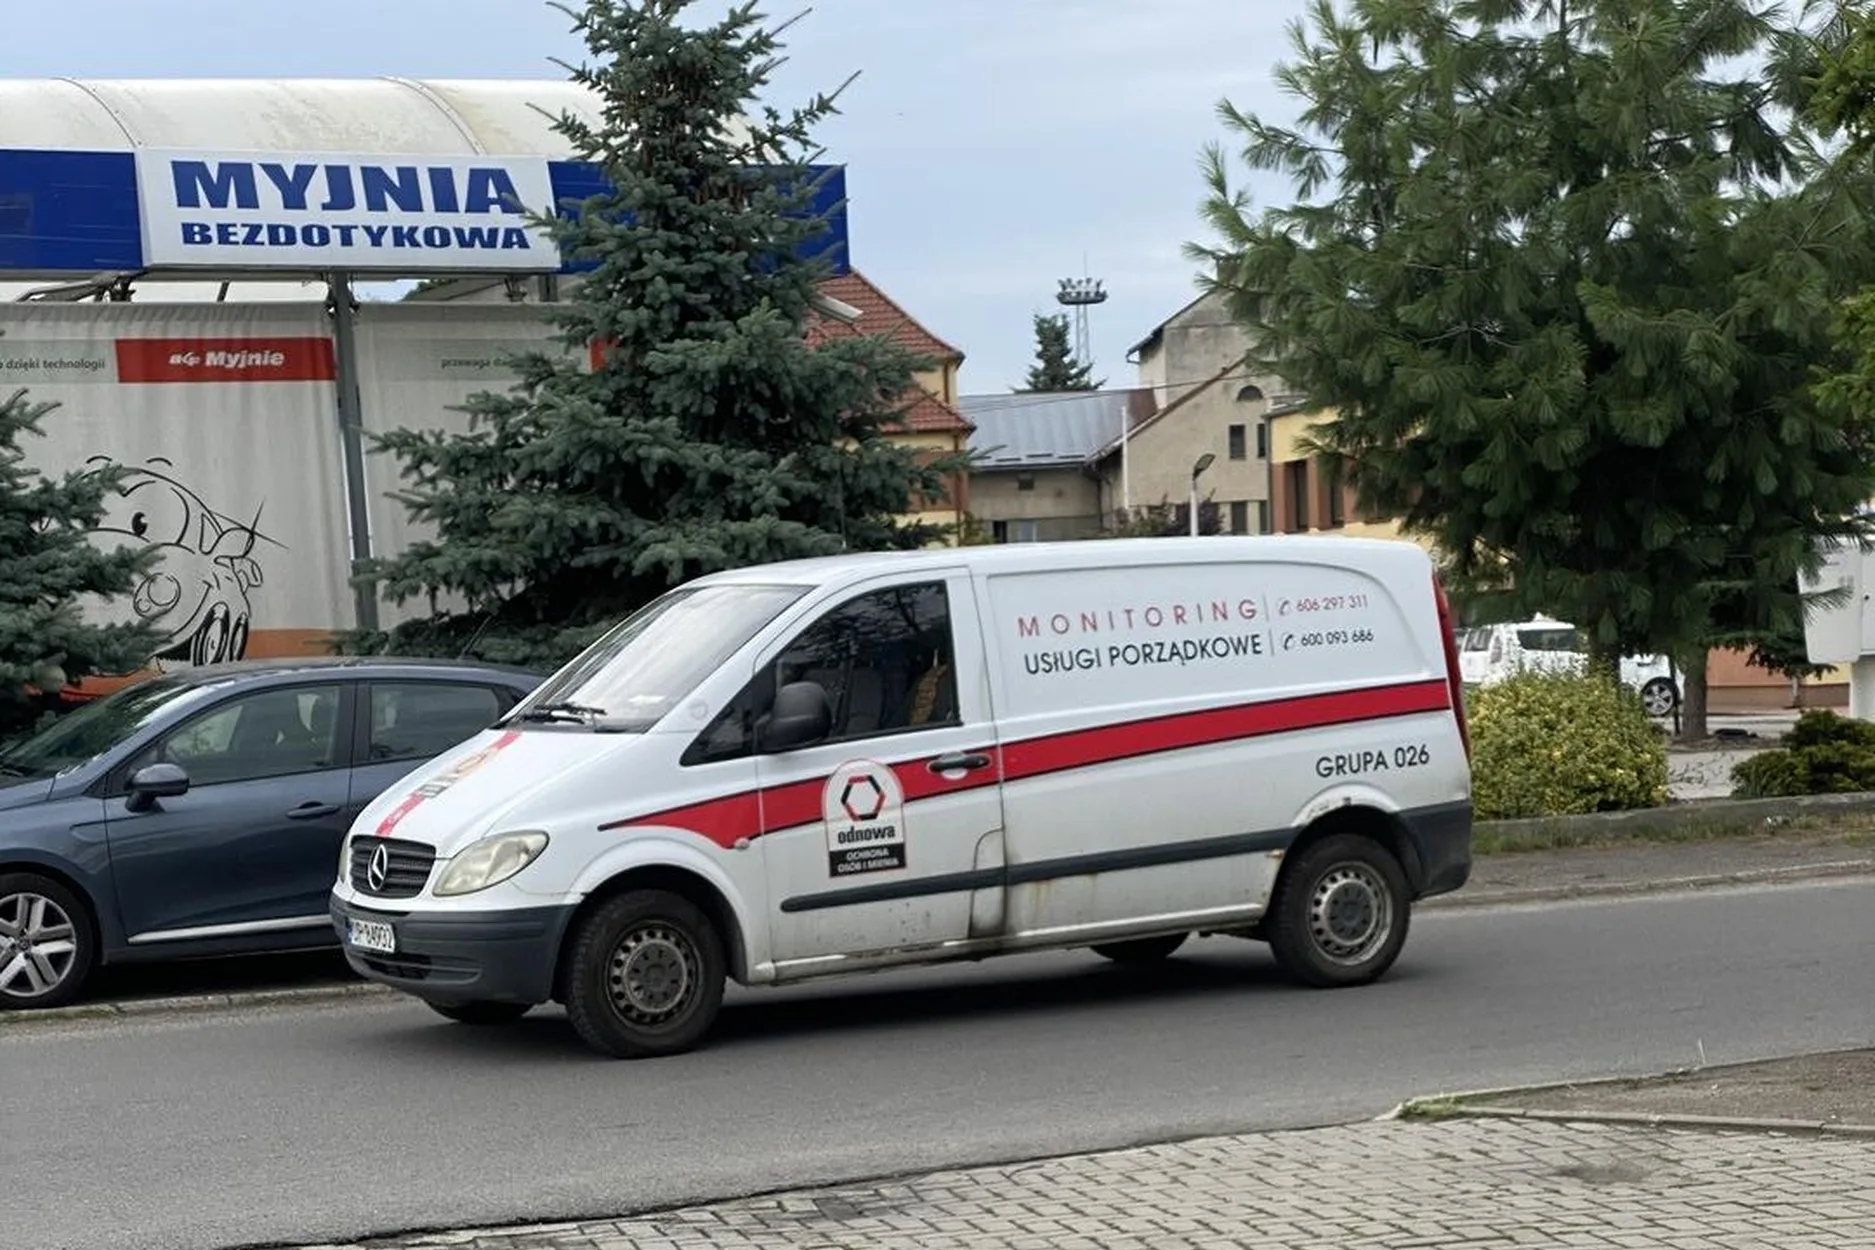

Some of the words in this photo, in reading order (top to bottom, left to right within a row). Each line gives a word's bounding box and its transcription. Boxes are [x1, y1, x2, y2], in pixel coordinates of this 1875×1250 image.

[171, 160, 526, 214] MYJNIA
[180, 222, 531, 249] BEZDOTYKOWA
[5, 358, 40, 372] dzięki
[43, 358, 105, 372] technologii
[205, 350, 285, 369] Myjnie
[1017, 600, 1257, 638] MONITORING
[1297, 598, 1321, 612] 606
[1322, 596, 1344, 611] 297
[1348, 594, 1368, 609] 311
[1108, 633, 1263, 667] PORZĄDKOWE
[1301, 632, 1324, 647] 600
[1325, 631, 1349, 645] 093
[1315, 750, 1389, 778] GRUPA
[1394, 743, 1430, 768] 026
[837, 825, 895, 844] odnowa
